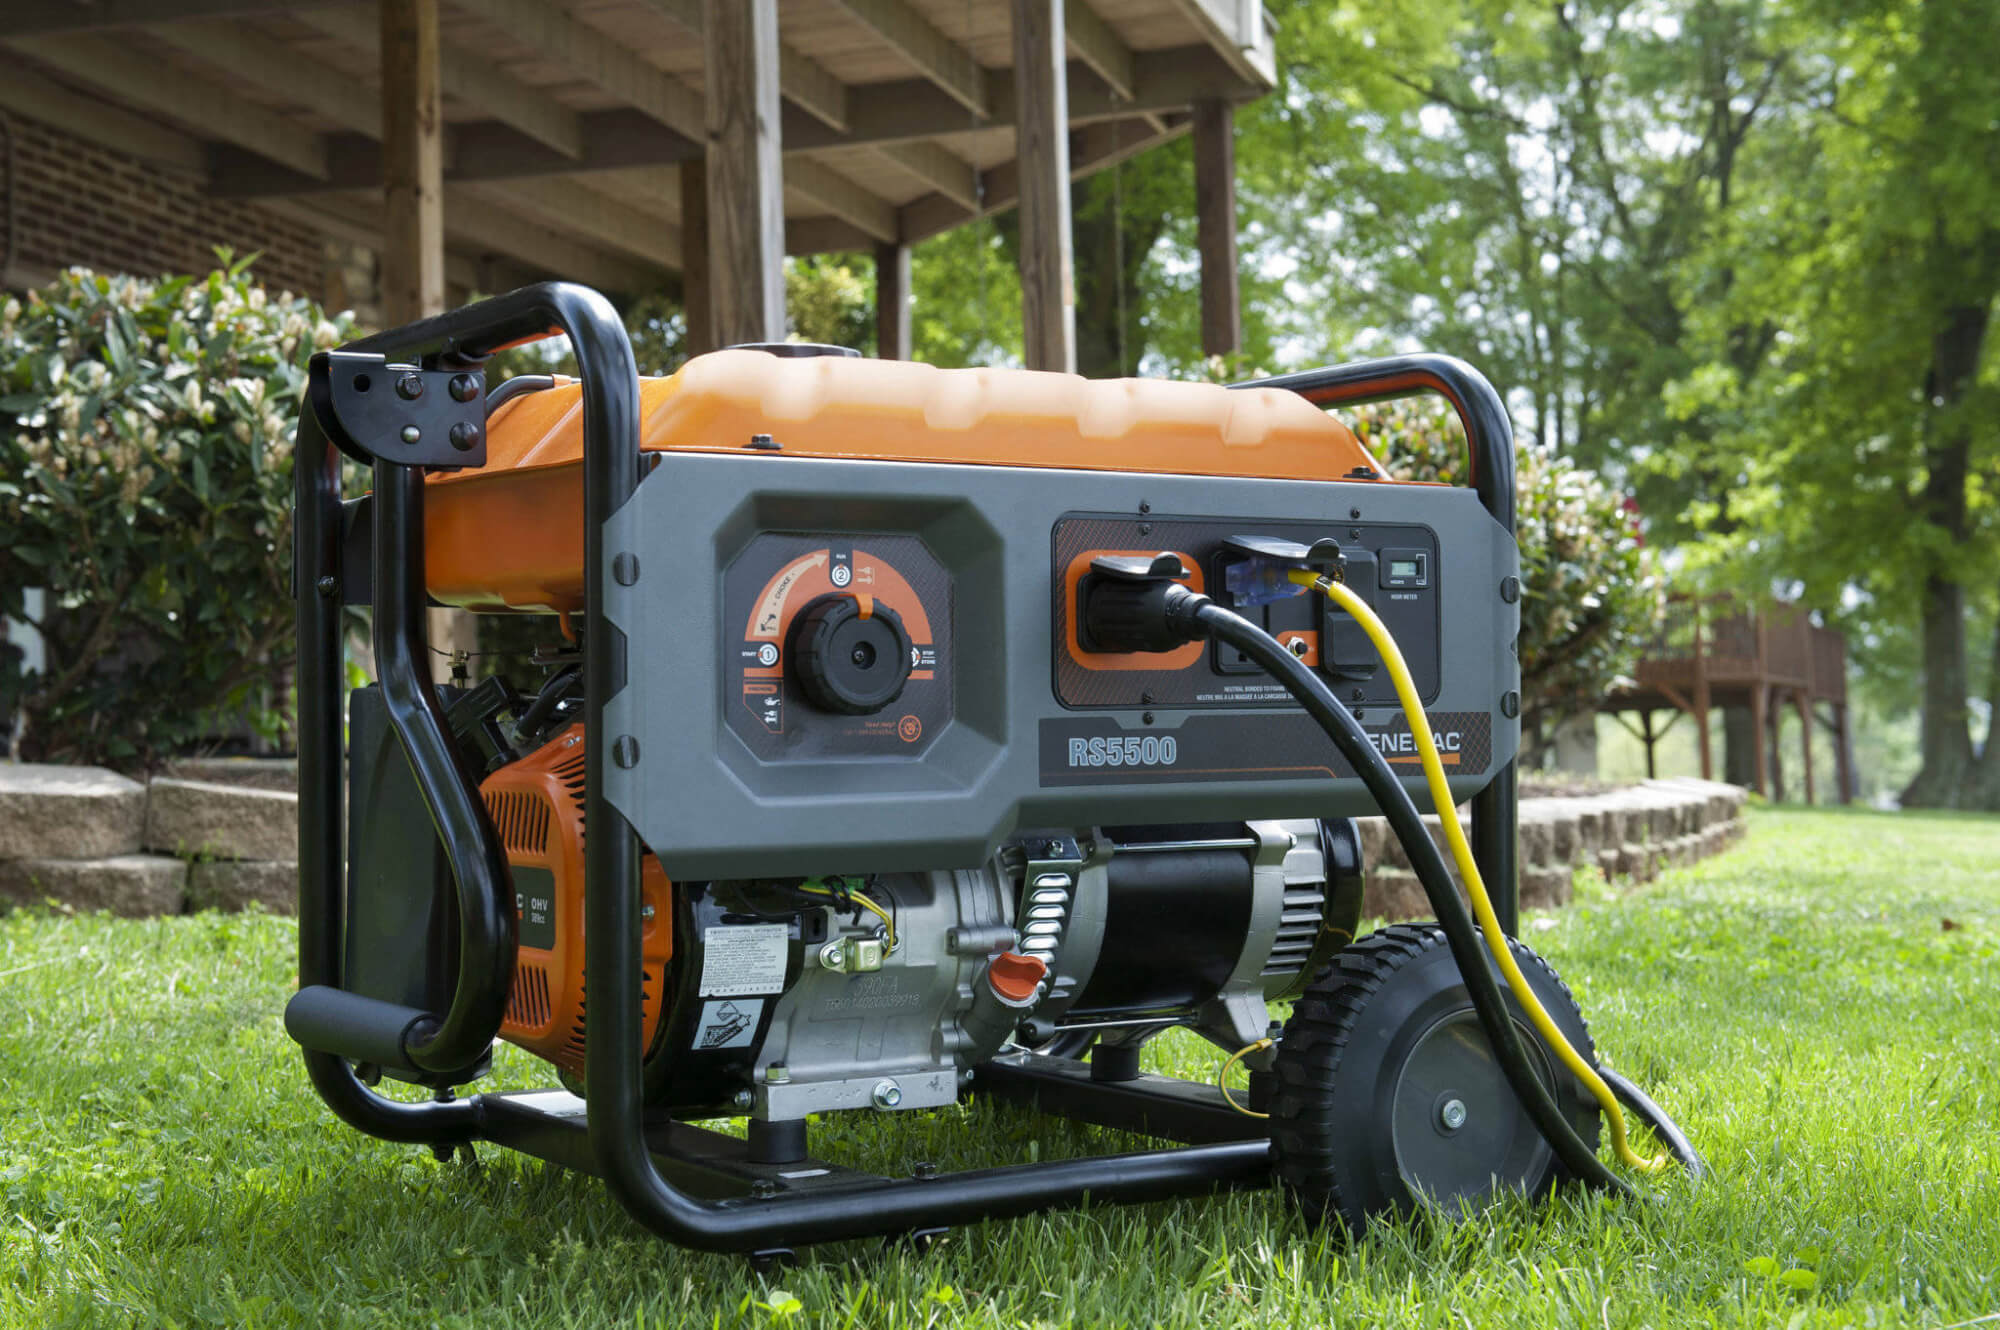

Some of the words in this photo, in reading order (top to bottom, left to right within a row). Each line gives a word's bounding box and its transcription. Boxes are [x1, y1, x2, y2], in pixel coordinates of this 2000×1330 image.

[775, 575, 792, 600] CHOKE
[1069, 736, 1177, 767] RS5500
[1368, 732, 1461, 752] ENEAC
[531, 897, 548, 911] OHV
